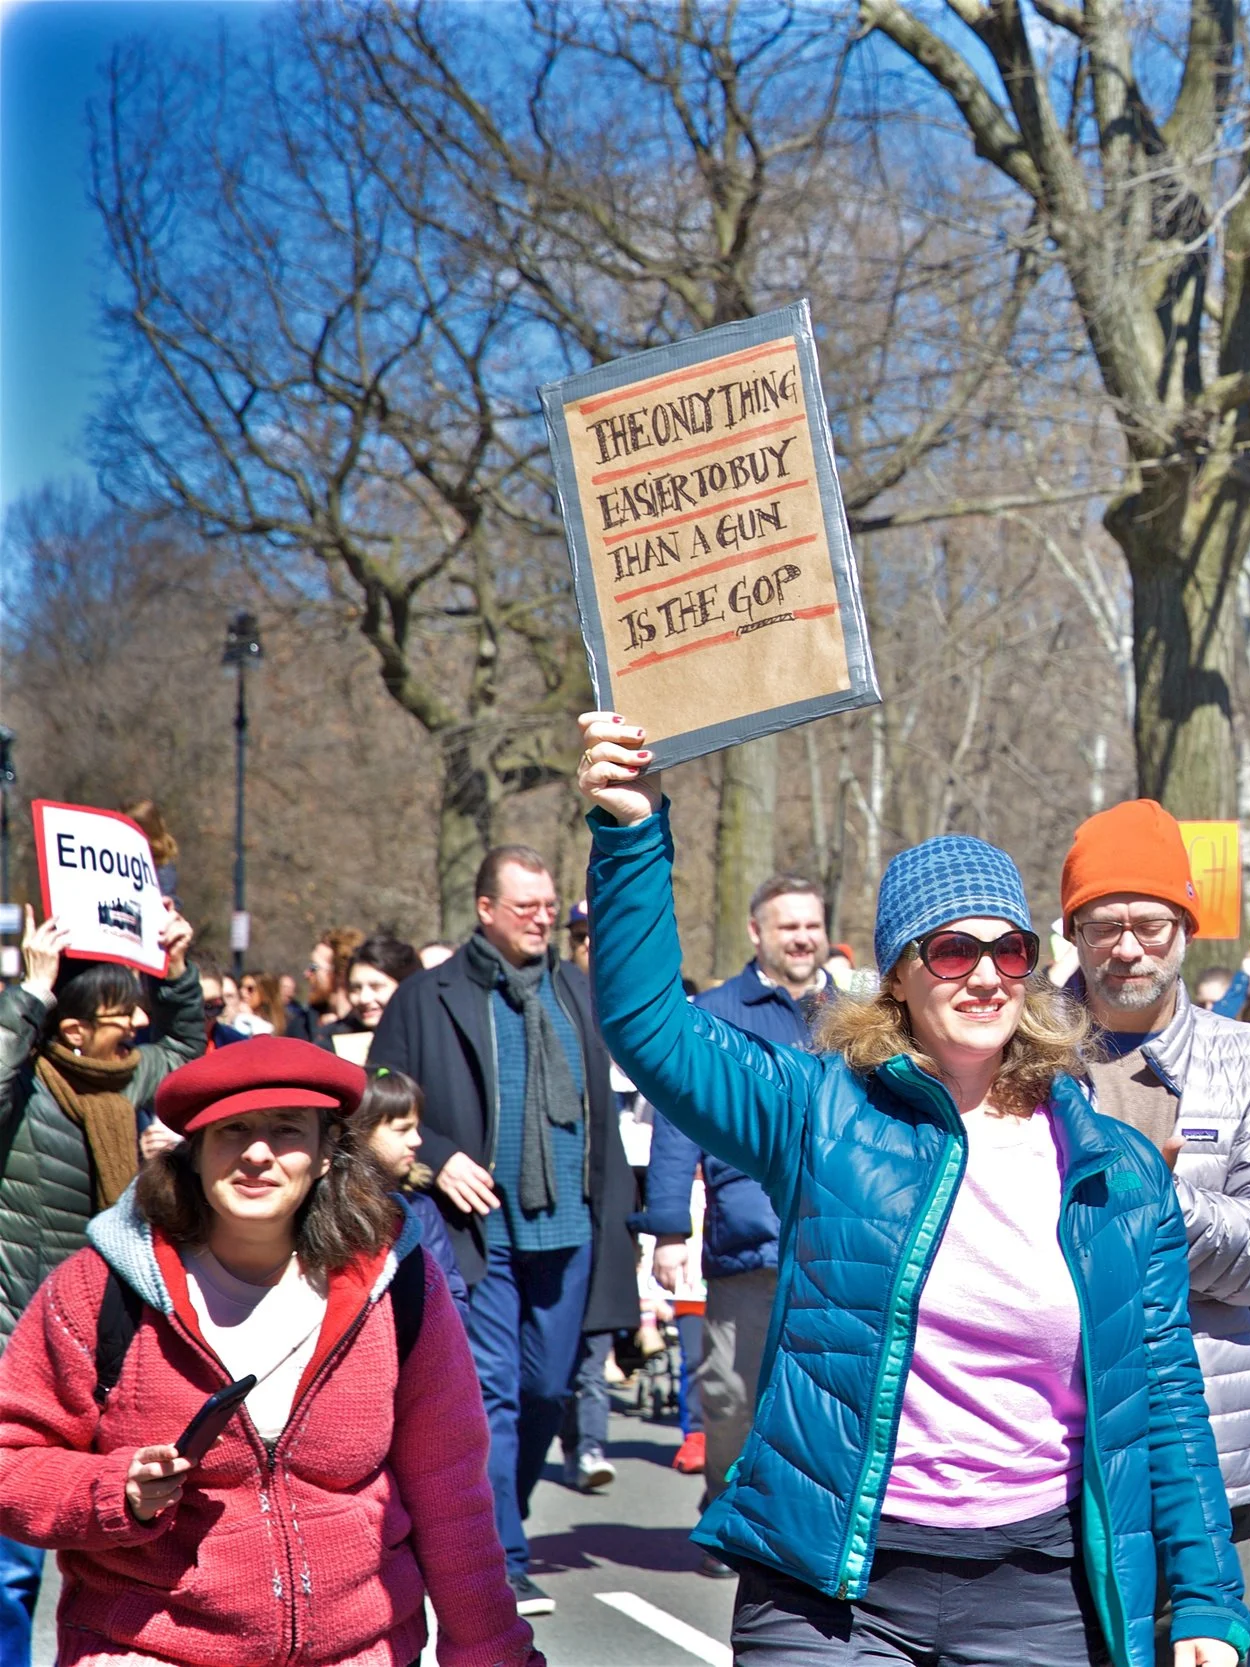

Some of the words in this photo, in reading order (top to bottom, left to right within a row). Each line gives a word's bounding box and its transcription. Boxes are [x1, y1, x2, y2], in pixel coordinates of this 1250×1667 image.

[586, 406, 654, 465] THE
[652, 388, 716, 446] ONLY
[690, 462, 728, 498] TO
[726, 436, 797, 490] BUY
[607, 531, 681, 583] THAN
[690, 524, 712, 560] A
[715, 501, 788, 551] GUN
[618, 608, 657, 651] IS
[656, 584, 725, 638] THE
[728, 564, 801, 622] GOP
